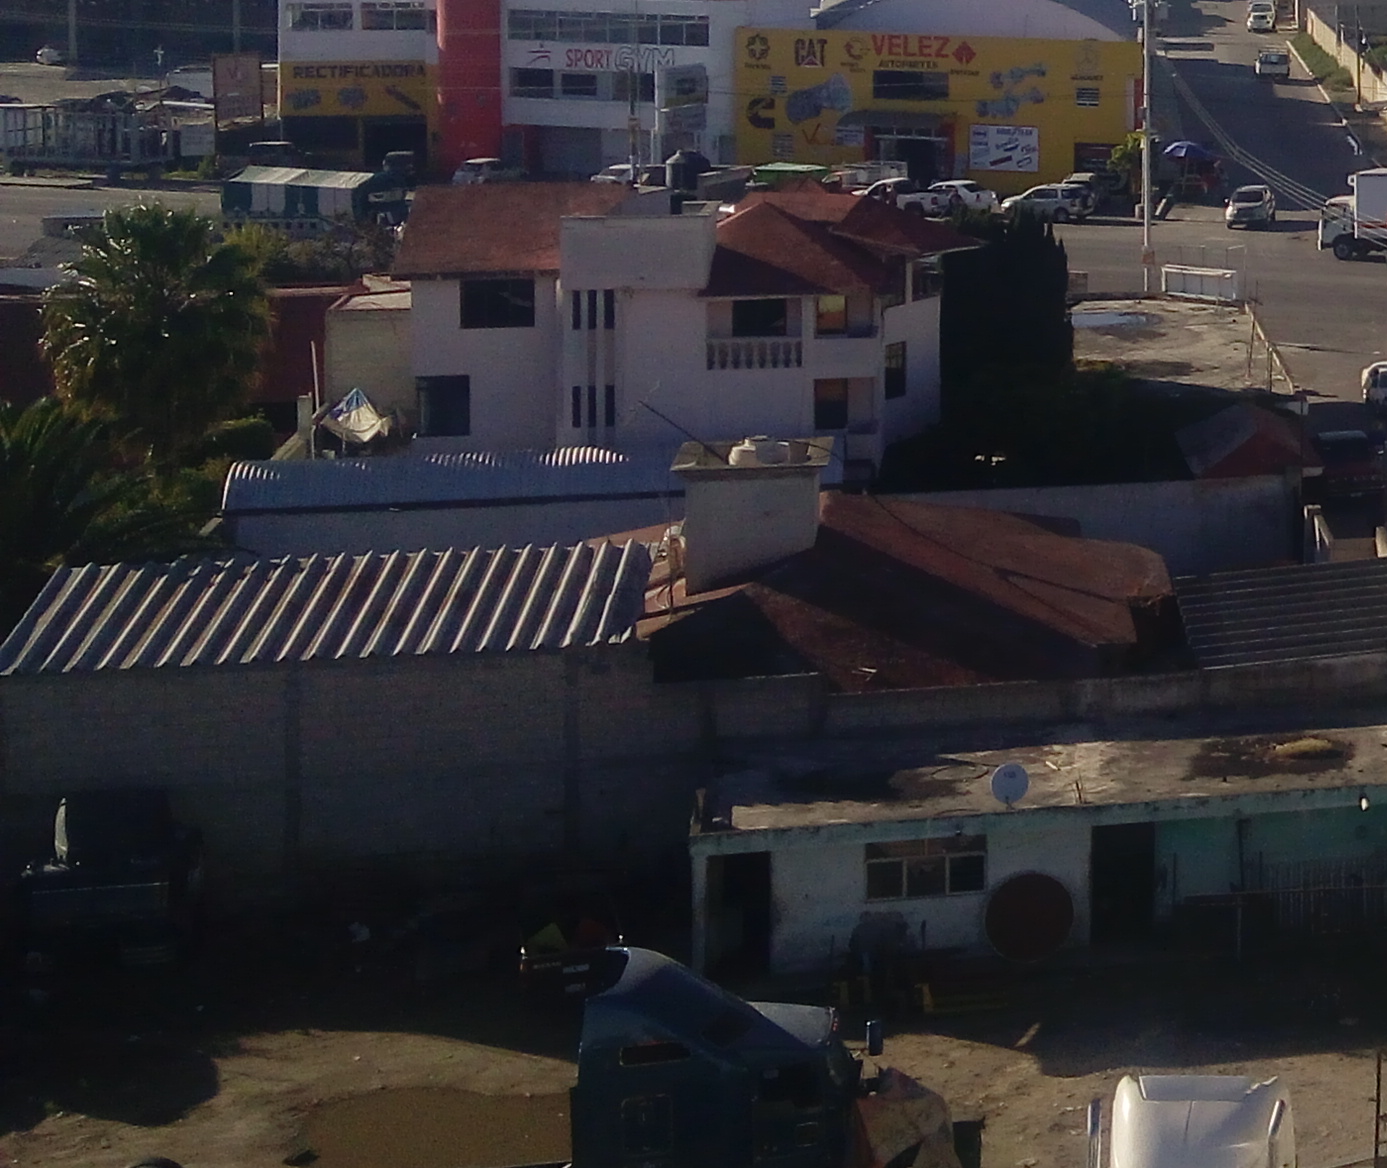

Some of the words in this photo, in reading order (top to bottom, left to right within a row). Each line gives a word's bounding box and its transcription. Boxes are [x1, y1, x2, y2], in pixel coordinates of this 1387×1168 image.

[565, 48, 613, 70] SPORT
[614, 45, 676, 71] GYM
[794, 38, 828, 67] CAT
[871, 33, 951, 59] VELEZ
[292, 64, 426, 79] RECTIFICADORA
